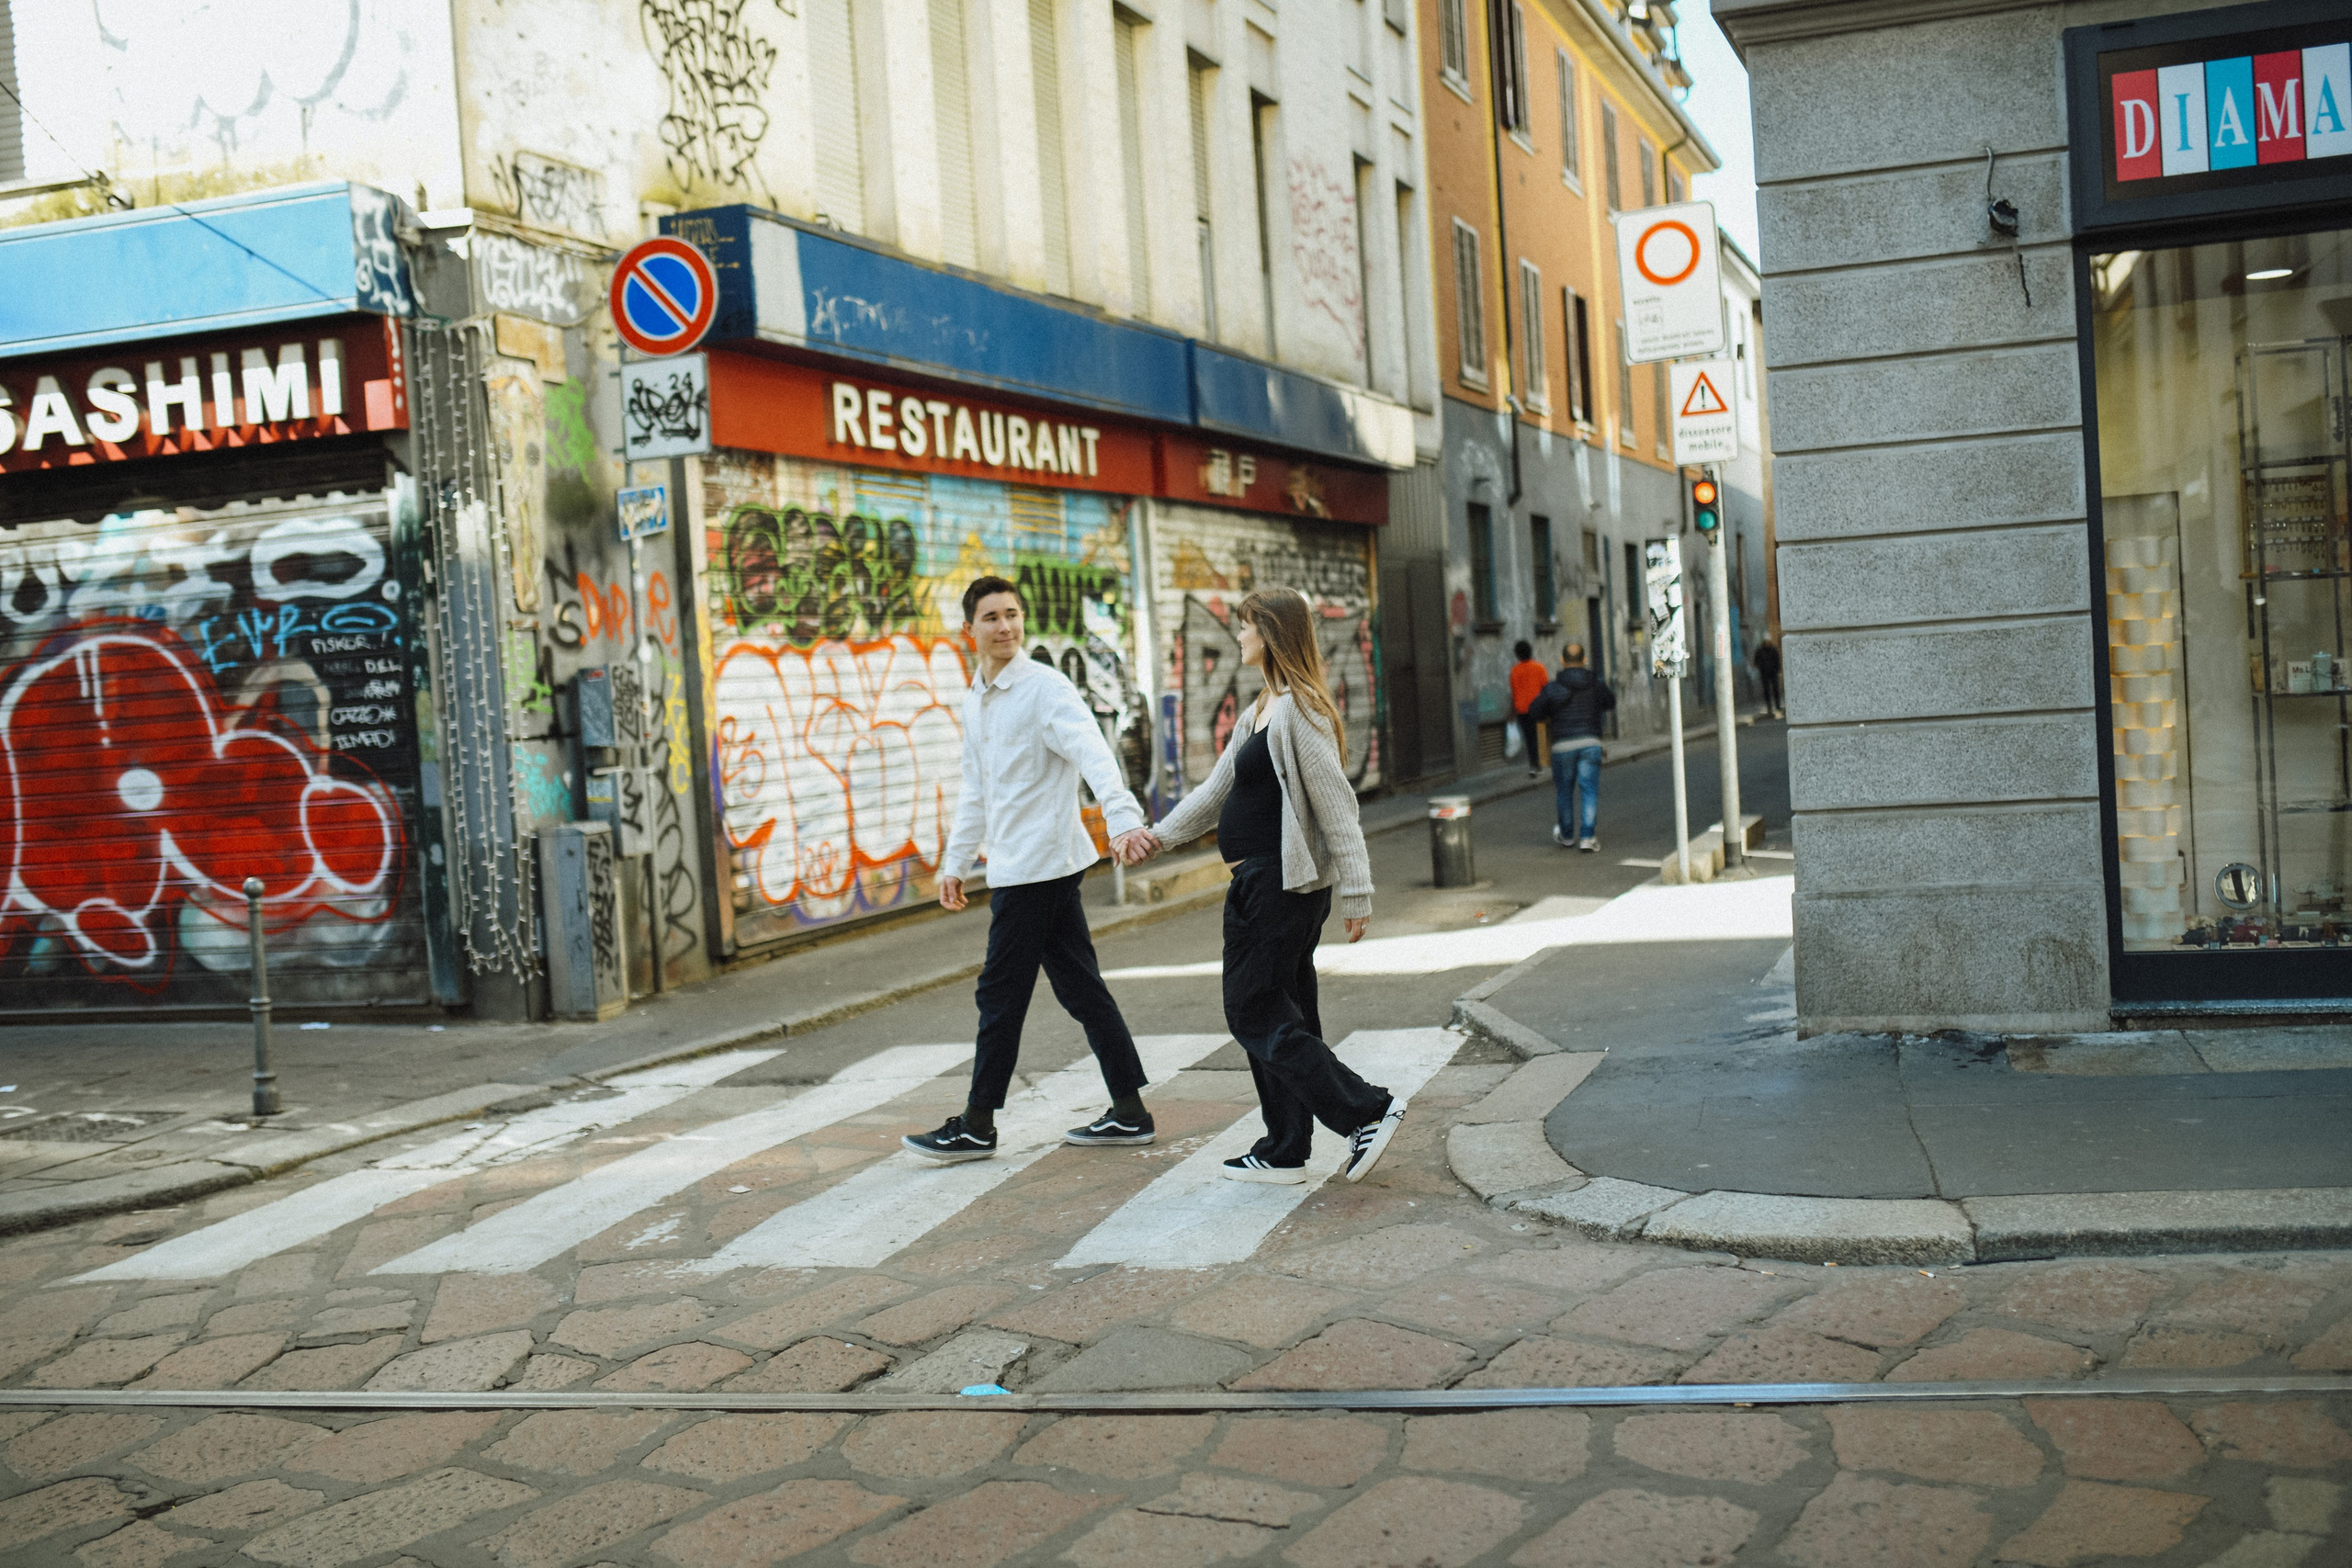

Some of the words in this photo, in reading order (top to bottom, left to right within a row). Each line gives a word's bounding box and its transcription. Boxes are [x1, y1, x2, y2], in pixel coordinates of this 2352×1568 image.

[2120, 73, 2346, 160] DIAMA
[832, 381, 1101, 477] RESTAURANT
[1679, 425, 1733, 438] dissuasore
[1689, 439, 1724, 451] mobile
